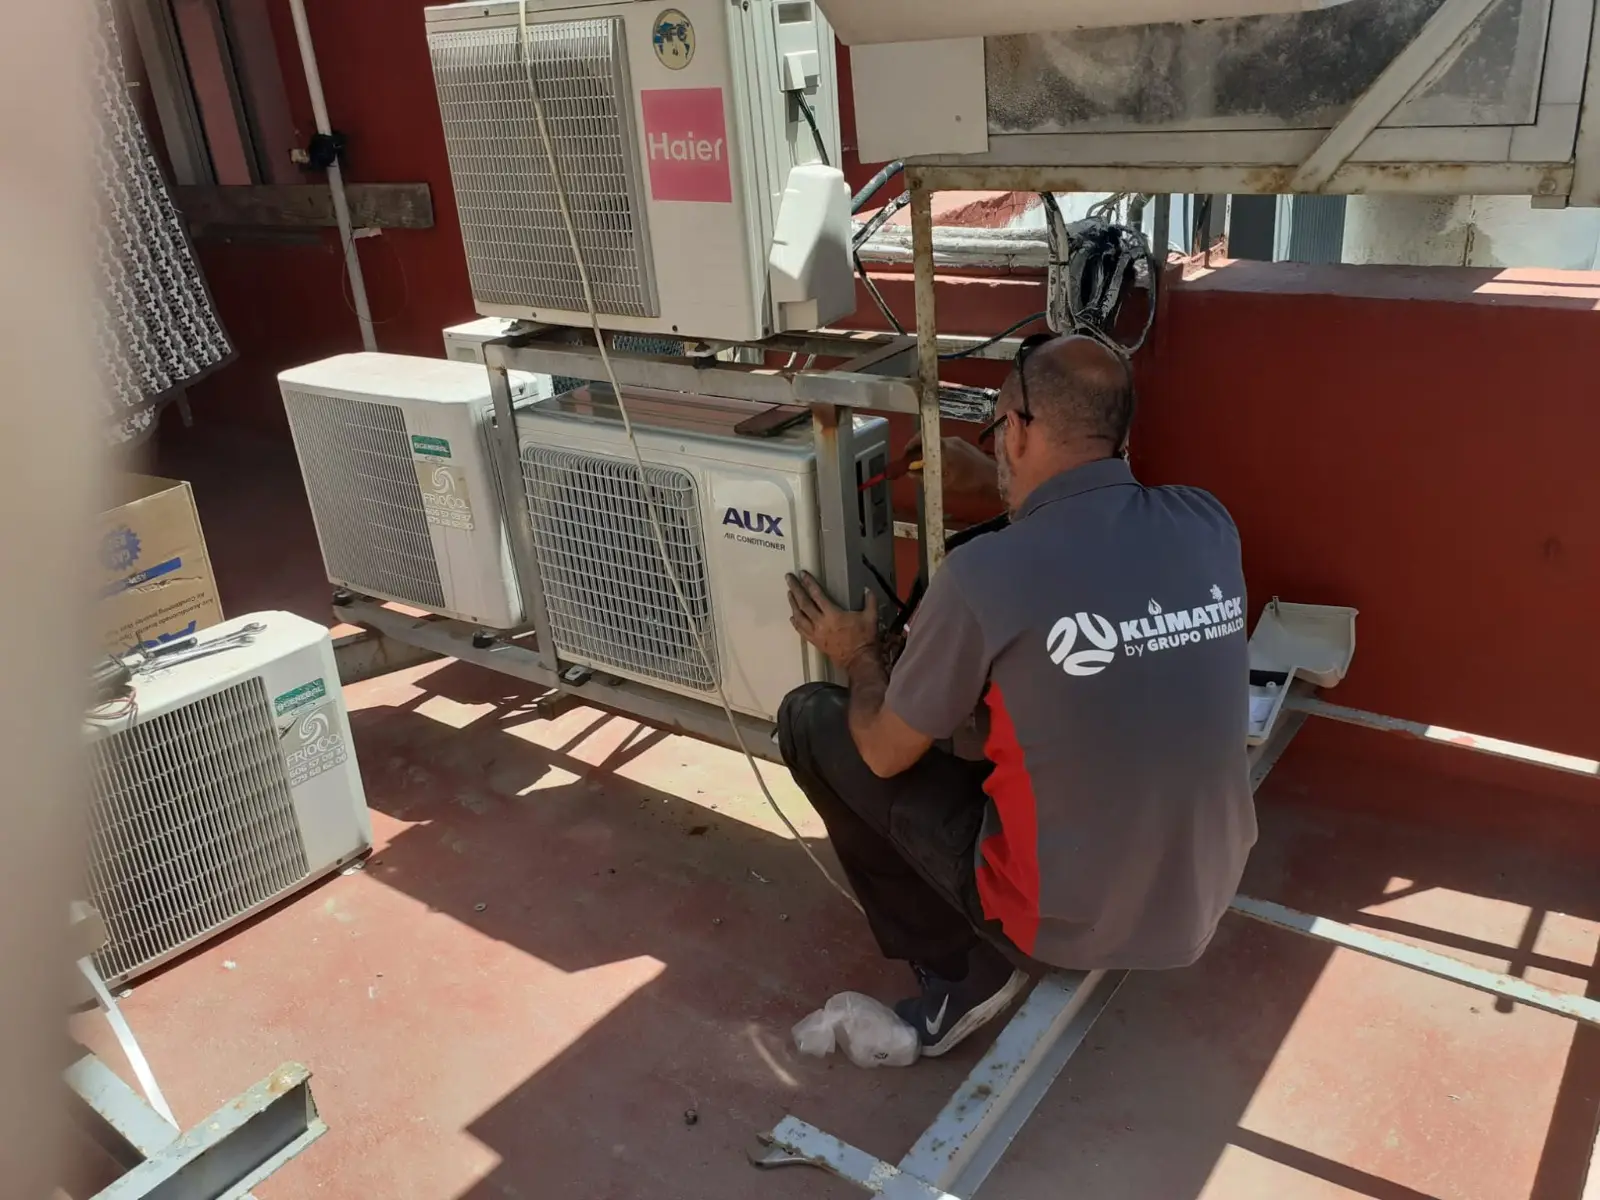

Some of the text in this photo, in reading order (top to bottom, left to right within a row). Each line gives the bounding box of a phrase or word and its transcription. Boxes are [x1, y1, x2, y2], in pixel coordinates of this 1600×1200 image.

[648, 131, 723, 161] Haier
[722, 507, 784, 537] AUX
[724, 532, 786, 551] AIR CONDITIONER
[1124, 617, 1244, 657] by GRUPO MIRALCO
